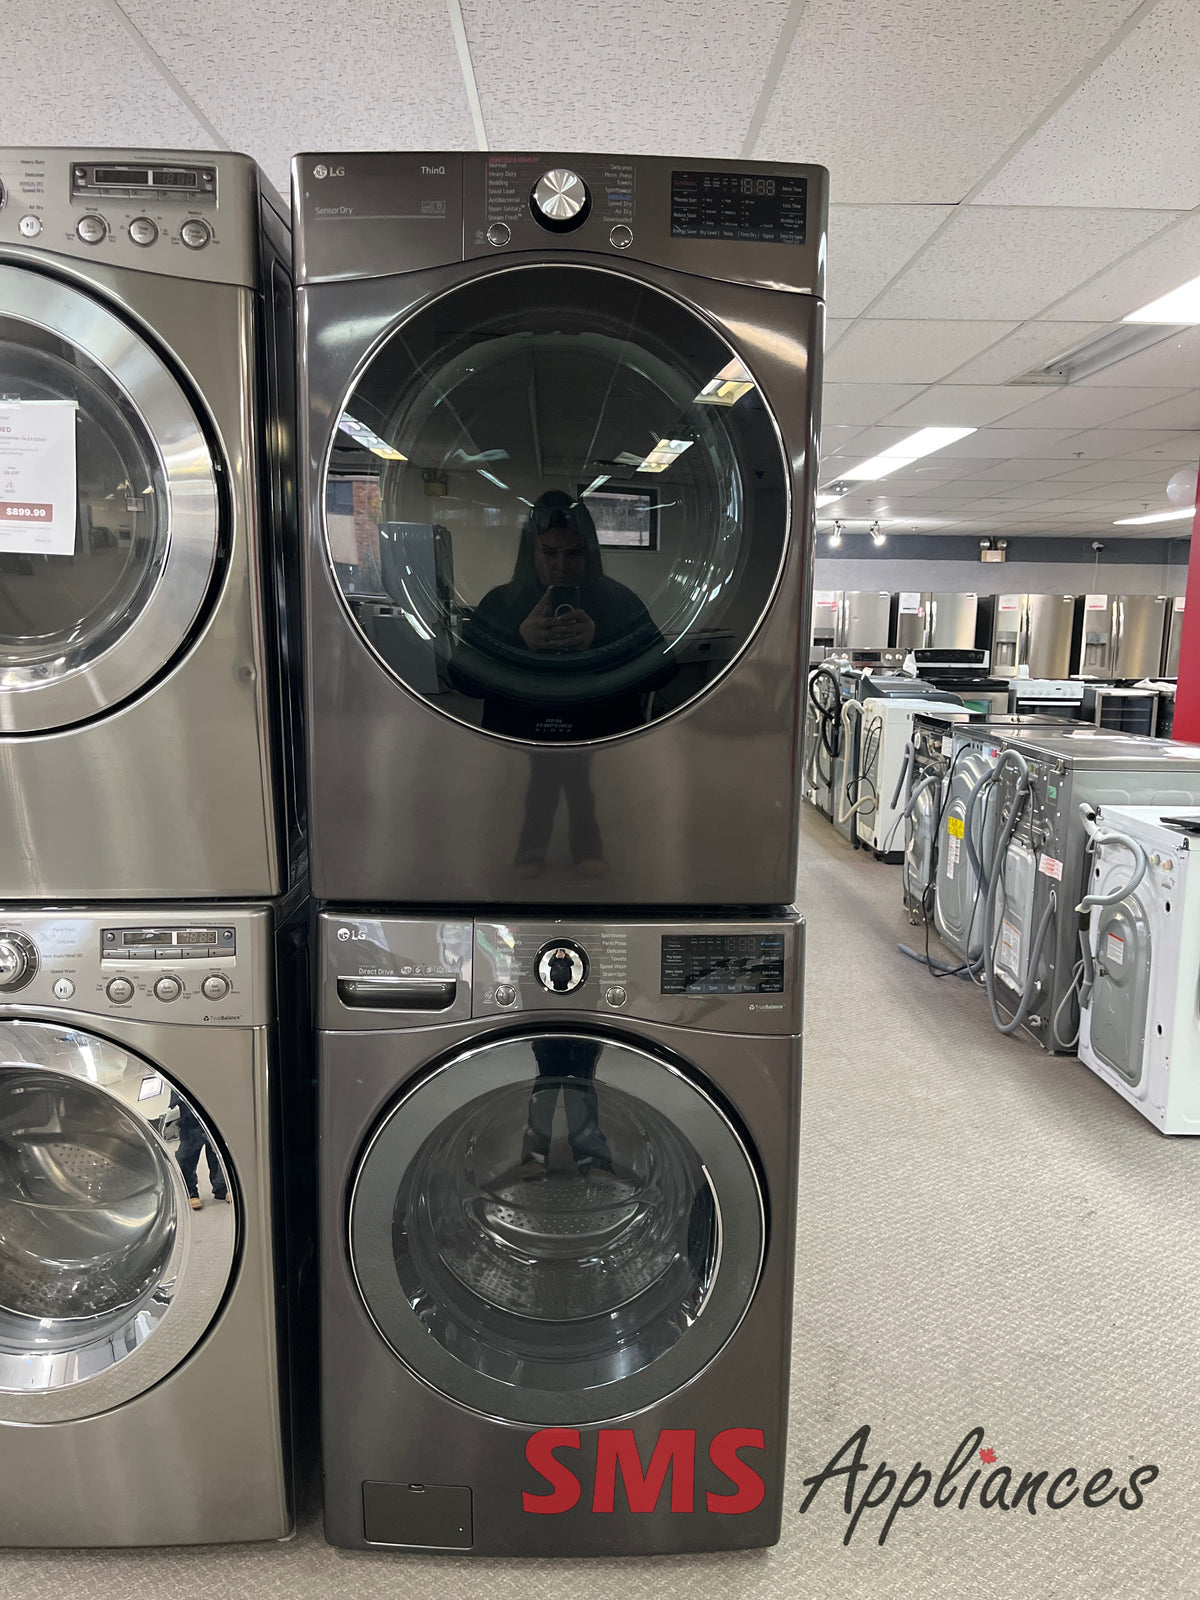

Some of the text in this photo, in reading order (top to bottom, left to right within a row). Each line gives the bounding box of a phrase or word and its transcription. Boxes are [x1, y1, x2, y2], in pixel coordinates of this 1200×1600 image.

[330, 166, 346, 177] LG
[420, 166, 446, 175] ThinQ
[6, 508, 46, 517] $899.99
[351, 930, 366, 940] LG
